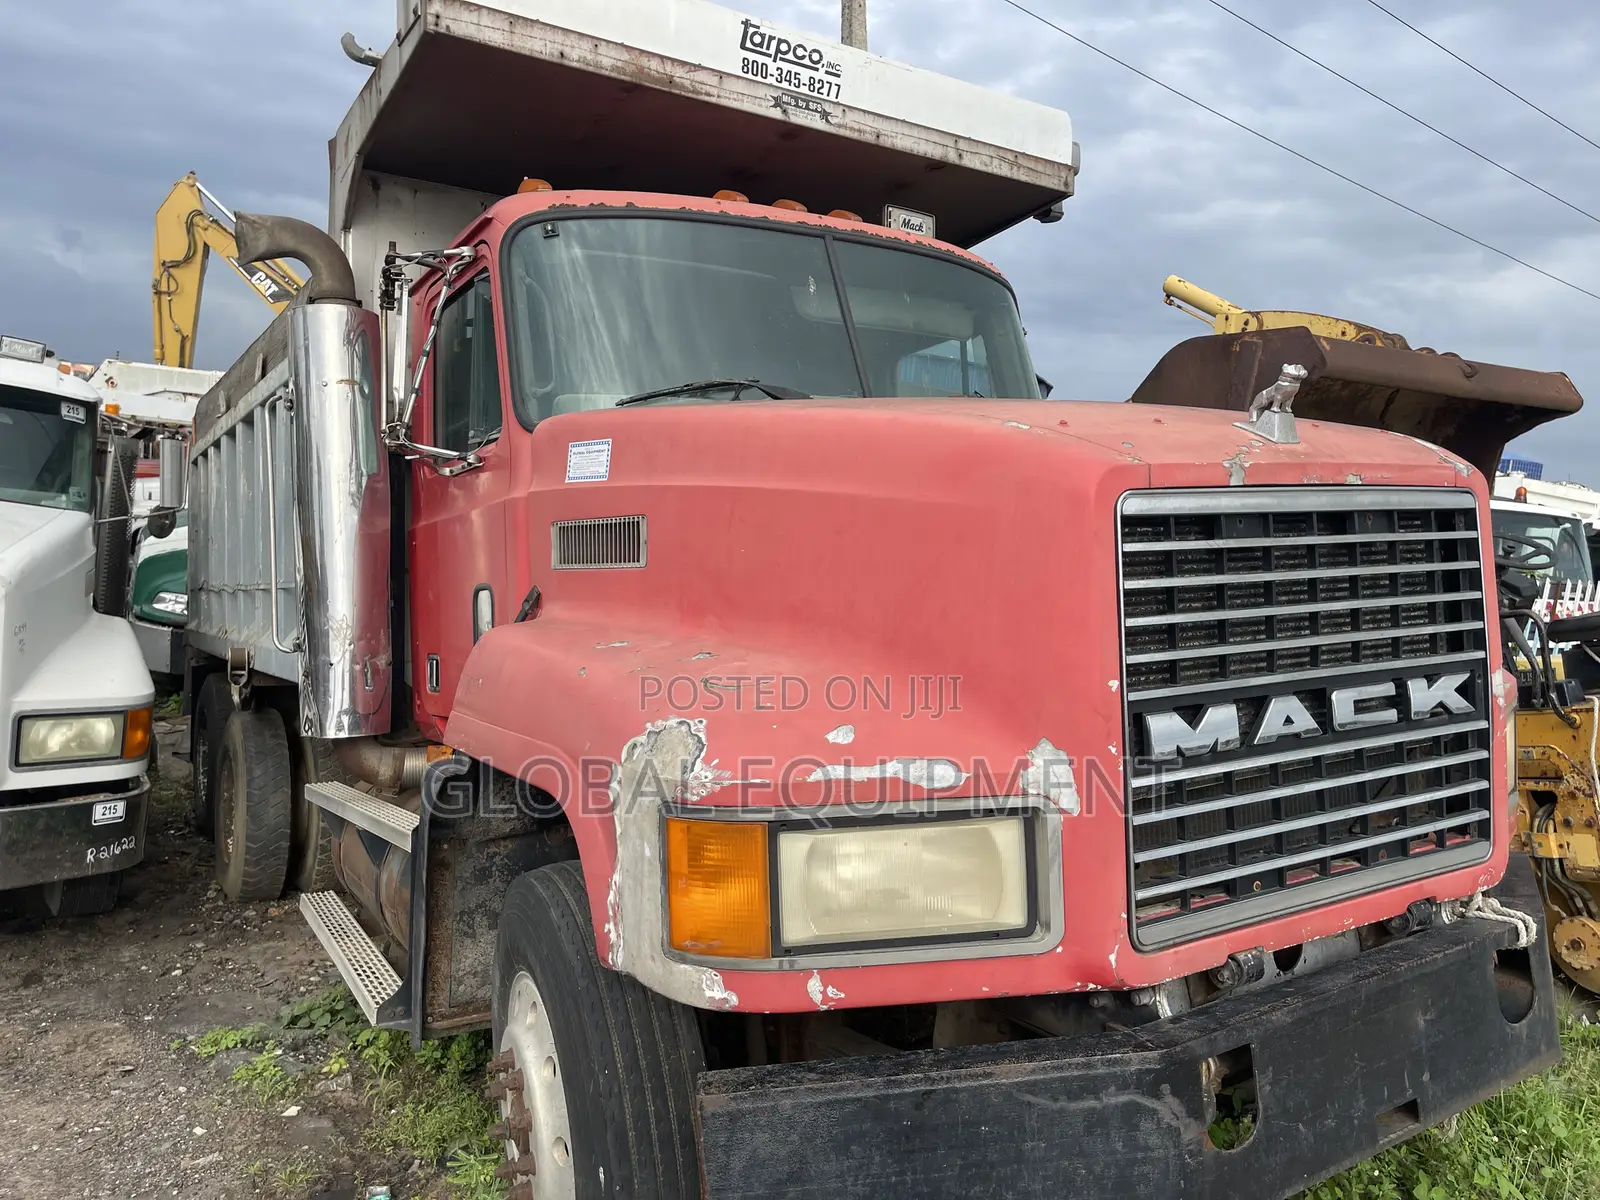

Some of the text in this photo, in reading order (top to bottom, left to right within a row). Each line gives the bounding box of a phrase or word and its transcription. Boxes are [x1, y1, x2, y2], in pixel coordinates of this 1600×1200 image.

[741, 57, 841, 100] 800-345-8277
[798, 99, 807, 109] by
[900, 217, 924, 233] Mack
[250, 271, 279, 297] CAT
[66, 405, 80, 416] 215
[1142, 672, 1476, 762] MACK
[101, 804, 118, 817] 215
